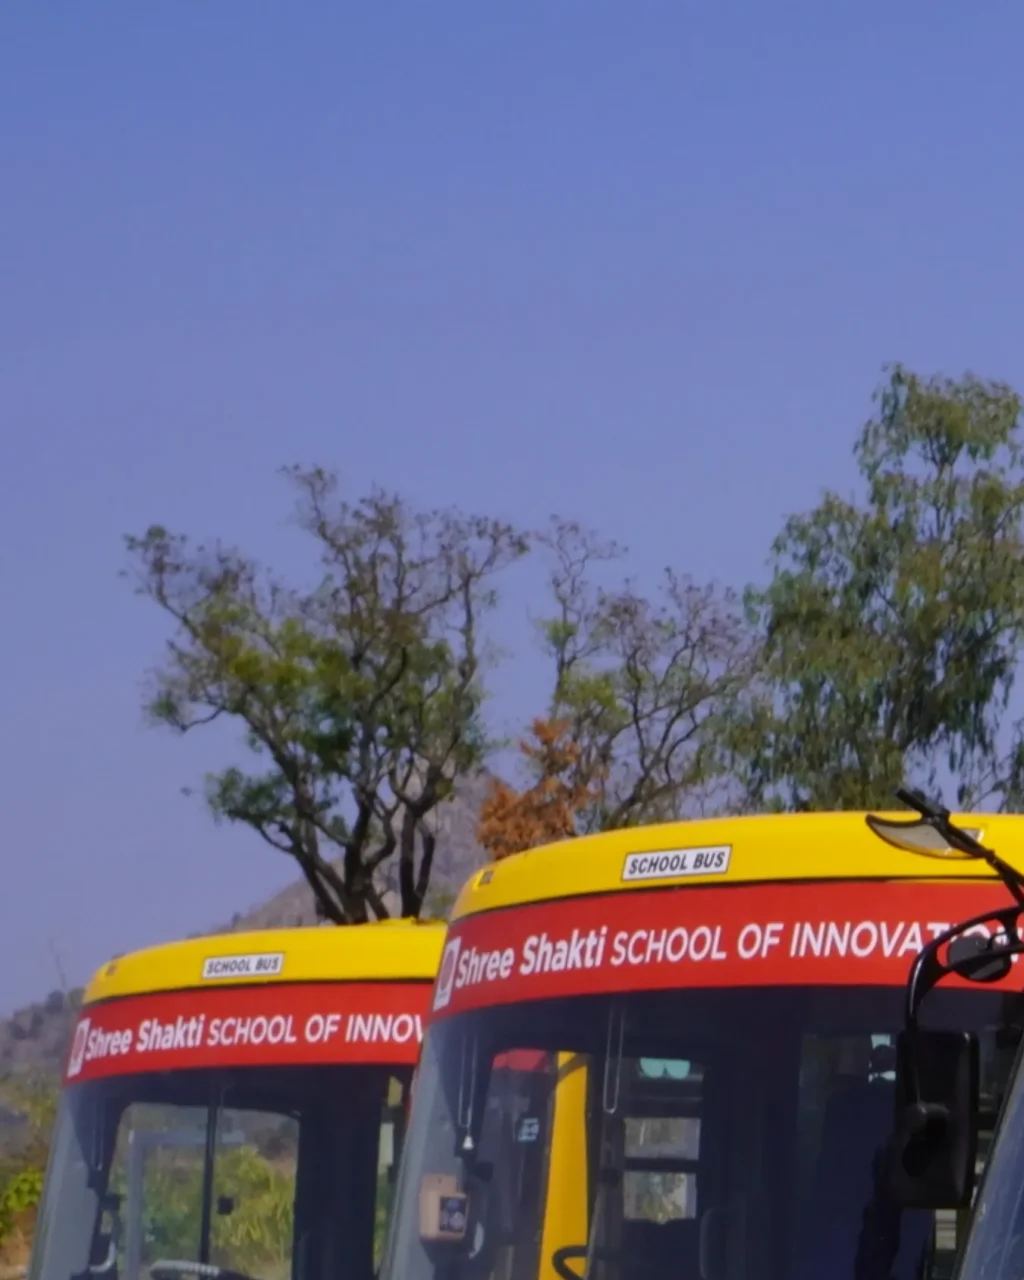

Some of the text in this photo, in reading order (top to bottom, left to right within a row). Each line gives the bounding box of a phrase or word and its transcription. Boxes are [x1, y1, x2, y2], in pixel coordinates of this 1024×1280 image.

[628, 851, 726, 874] SCHOOL BUS
[206, 956, 280, 974] SCHOOL BUS
[454, 920, 1024, 988] Shree Shakti SCHOOL OF INNOVAT
[84, 1026, 133, 1061] Shree
[136, 1014, 206, 1051] Shakti
[207, 1014, 298, 1047] SCHOOL
[305, 1013, 341, 1044] OF
